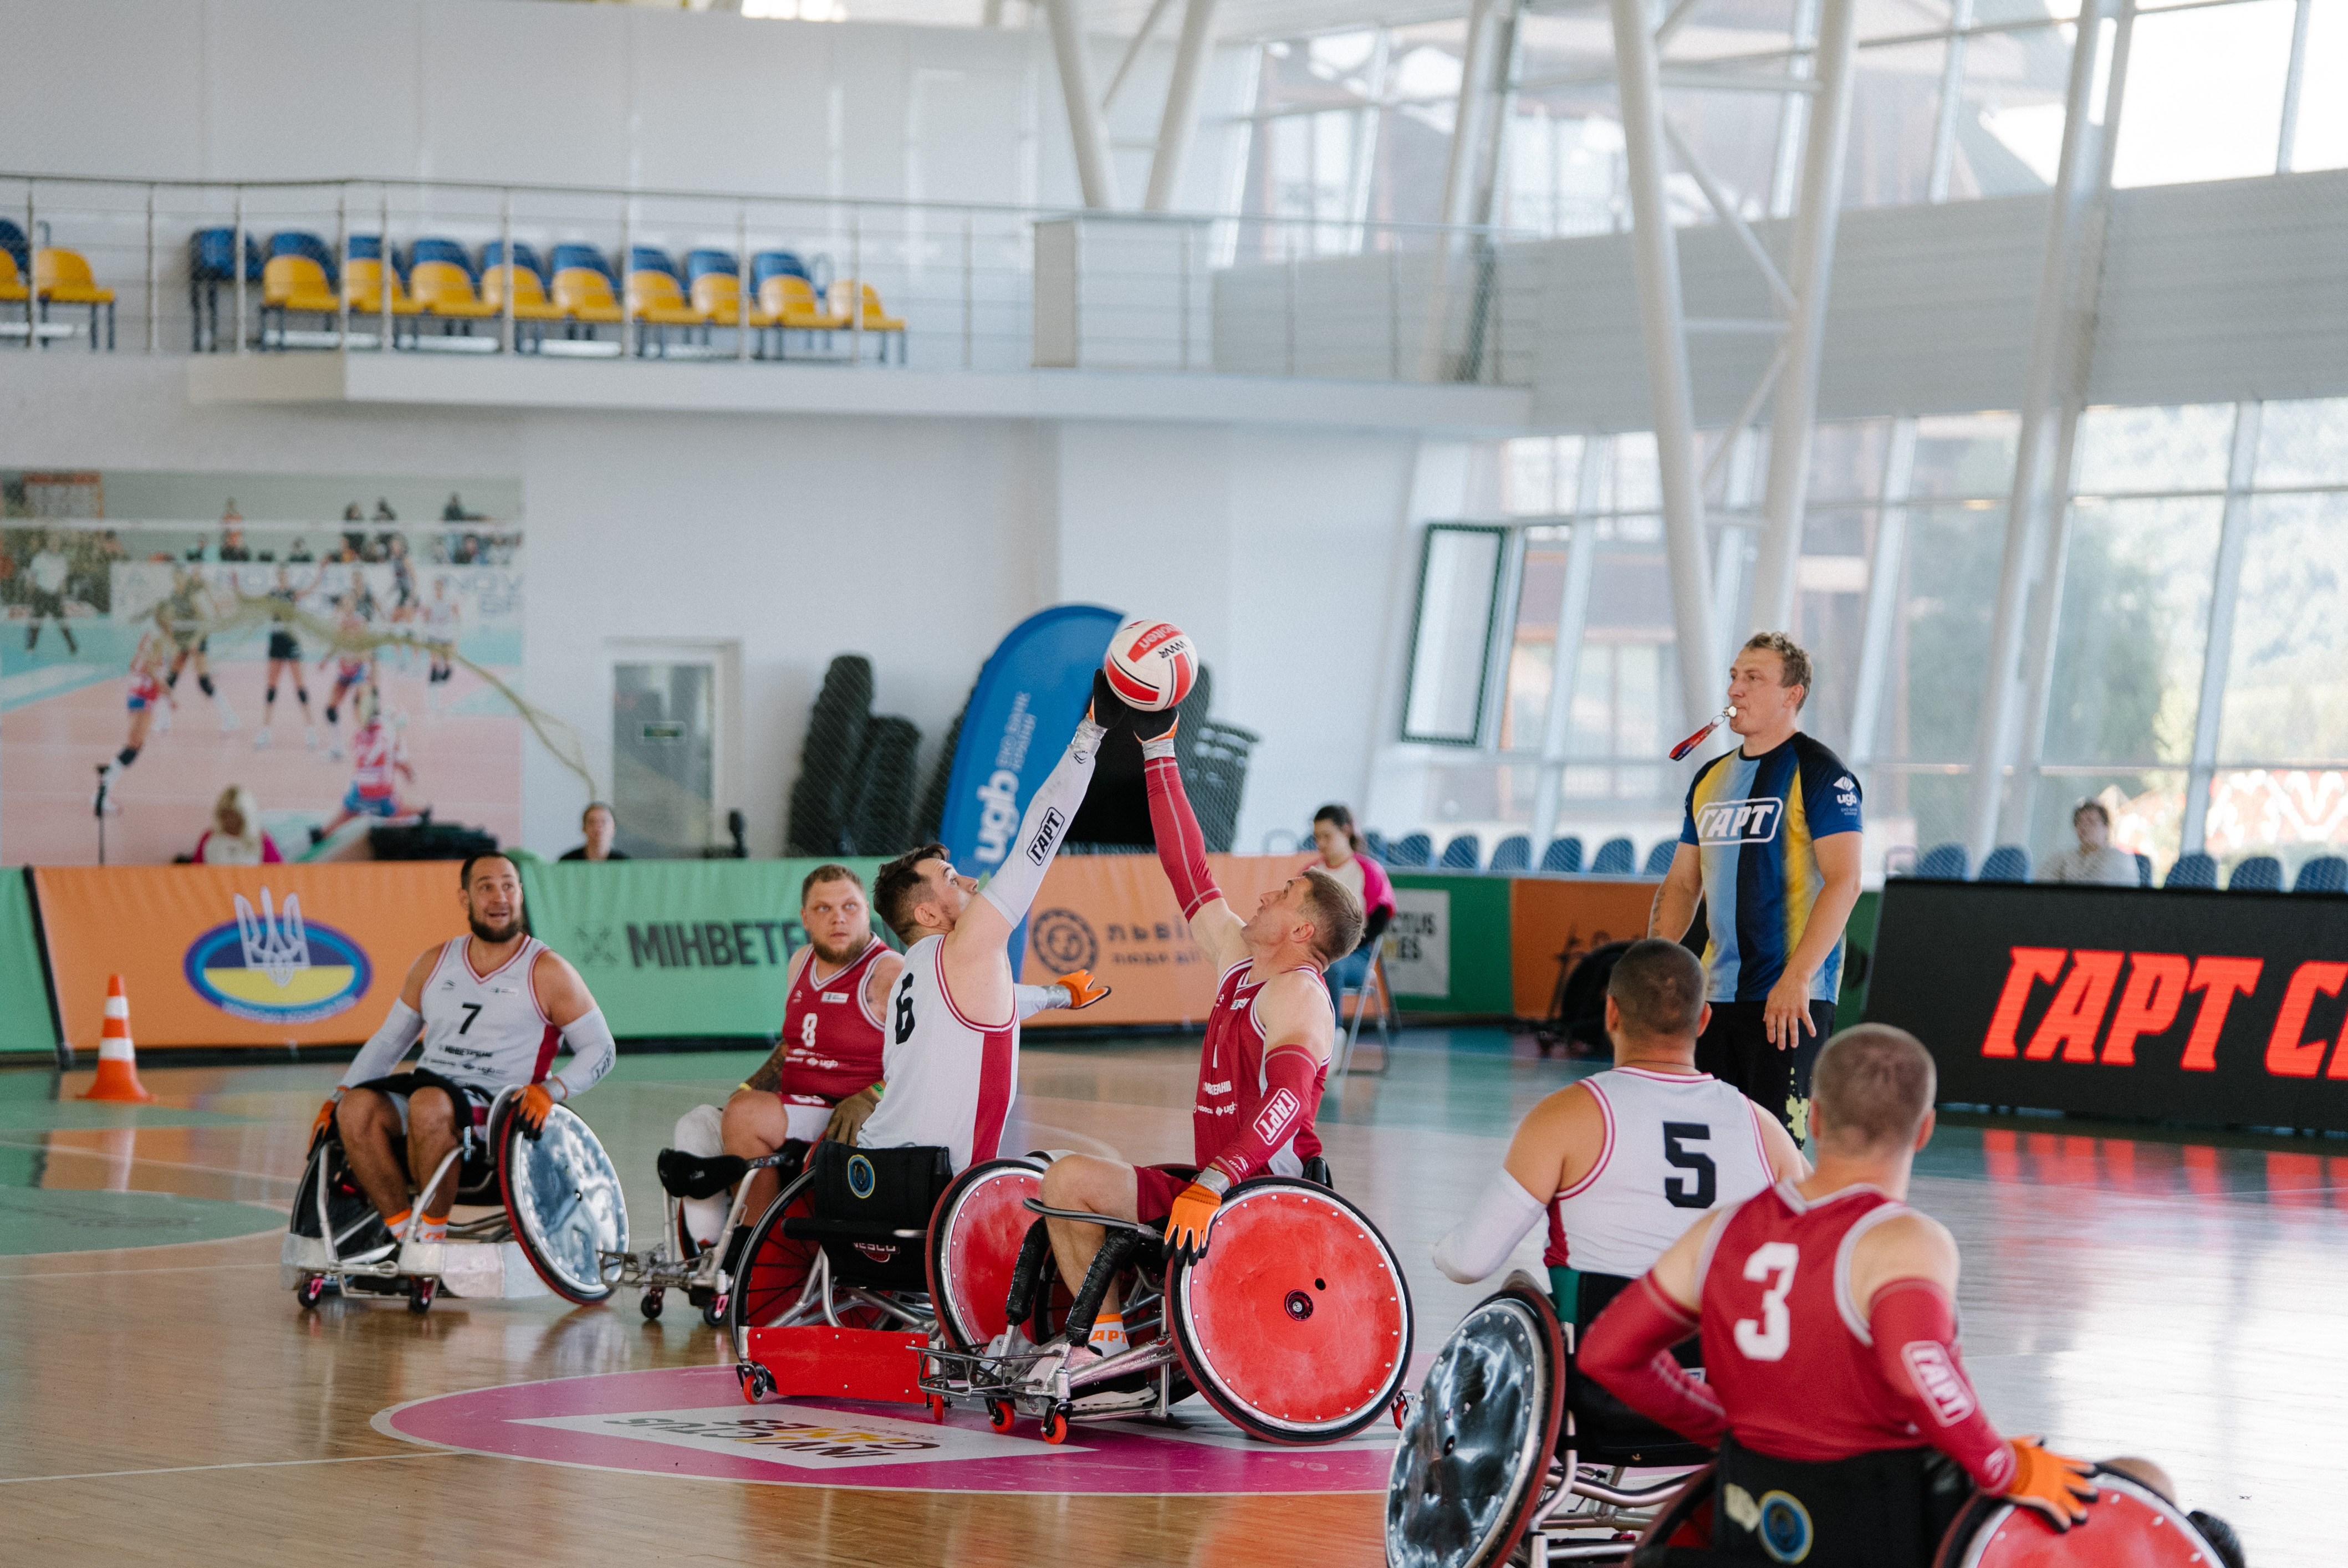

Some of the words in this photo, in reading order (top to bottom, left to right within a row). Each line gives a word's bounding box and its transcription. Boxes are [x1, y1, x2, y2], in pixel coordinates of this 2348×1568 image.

[974, 769, 1020, 863] ugb
[1697, 805, 1775, 838] ГАРТ
[1836, 791, 1857, 806] ugb
[1030, 811, 1060, 861] ГАРТ
[625, 920, 813, 968] МІНВЕТЕ
[459, 1002, 483, 1035] 7
[802, 1013, 818, 1048] 8
[895, 972, 916, 1045] 6
[1981, 946, 2265, 1072] ГАРТ
[1259, 1091, 1296, 1141] ГАРТ
[1662, 1120, 1716, 1209] 5
[1733, 1242, 1799, 1362] 3
[603, 1418, 897, 1458] INVICTUS
[712, 1419, 941, 1450] GAMES
